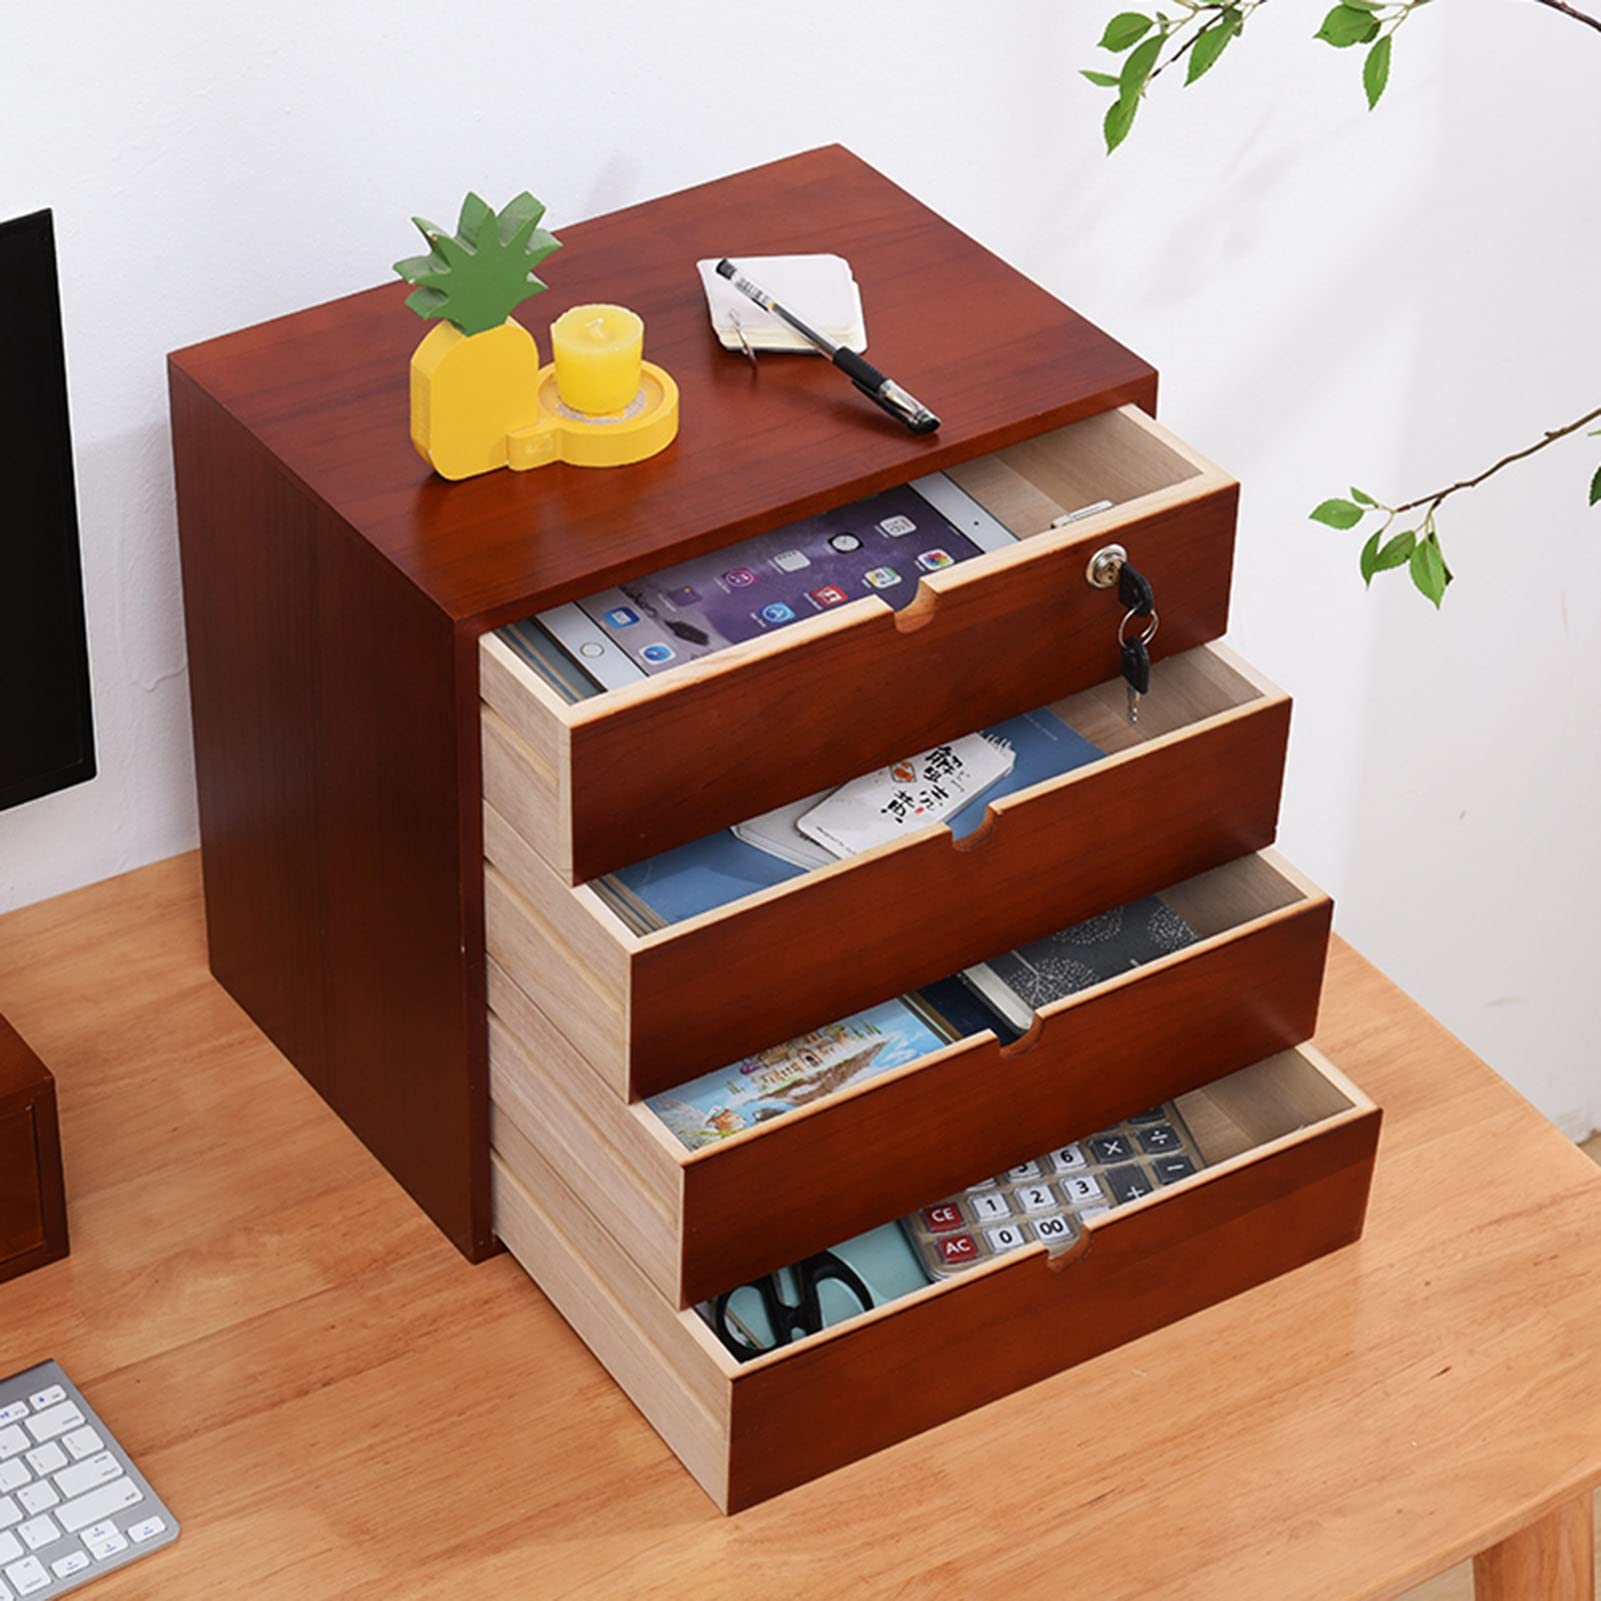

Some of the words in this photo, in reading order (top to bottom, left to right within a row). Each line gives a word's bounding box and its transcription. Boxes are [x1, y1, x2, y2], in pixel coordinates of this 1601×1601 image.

[1060, 1150, 1074, 1164] 6
[1077, 1181, 1089, 1195] 3
[1031, 1190, 1045, 1204] 2
[986, 1199, 997, 1212] 1
[931, 1208, 953, 1223] CE
[1039, 1219, 1064, 1236] 00
[999, 1230, 1013, 1244] 0
[945, 1238, 971, 1254] AC
